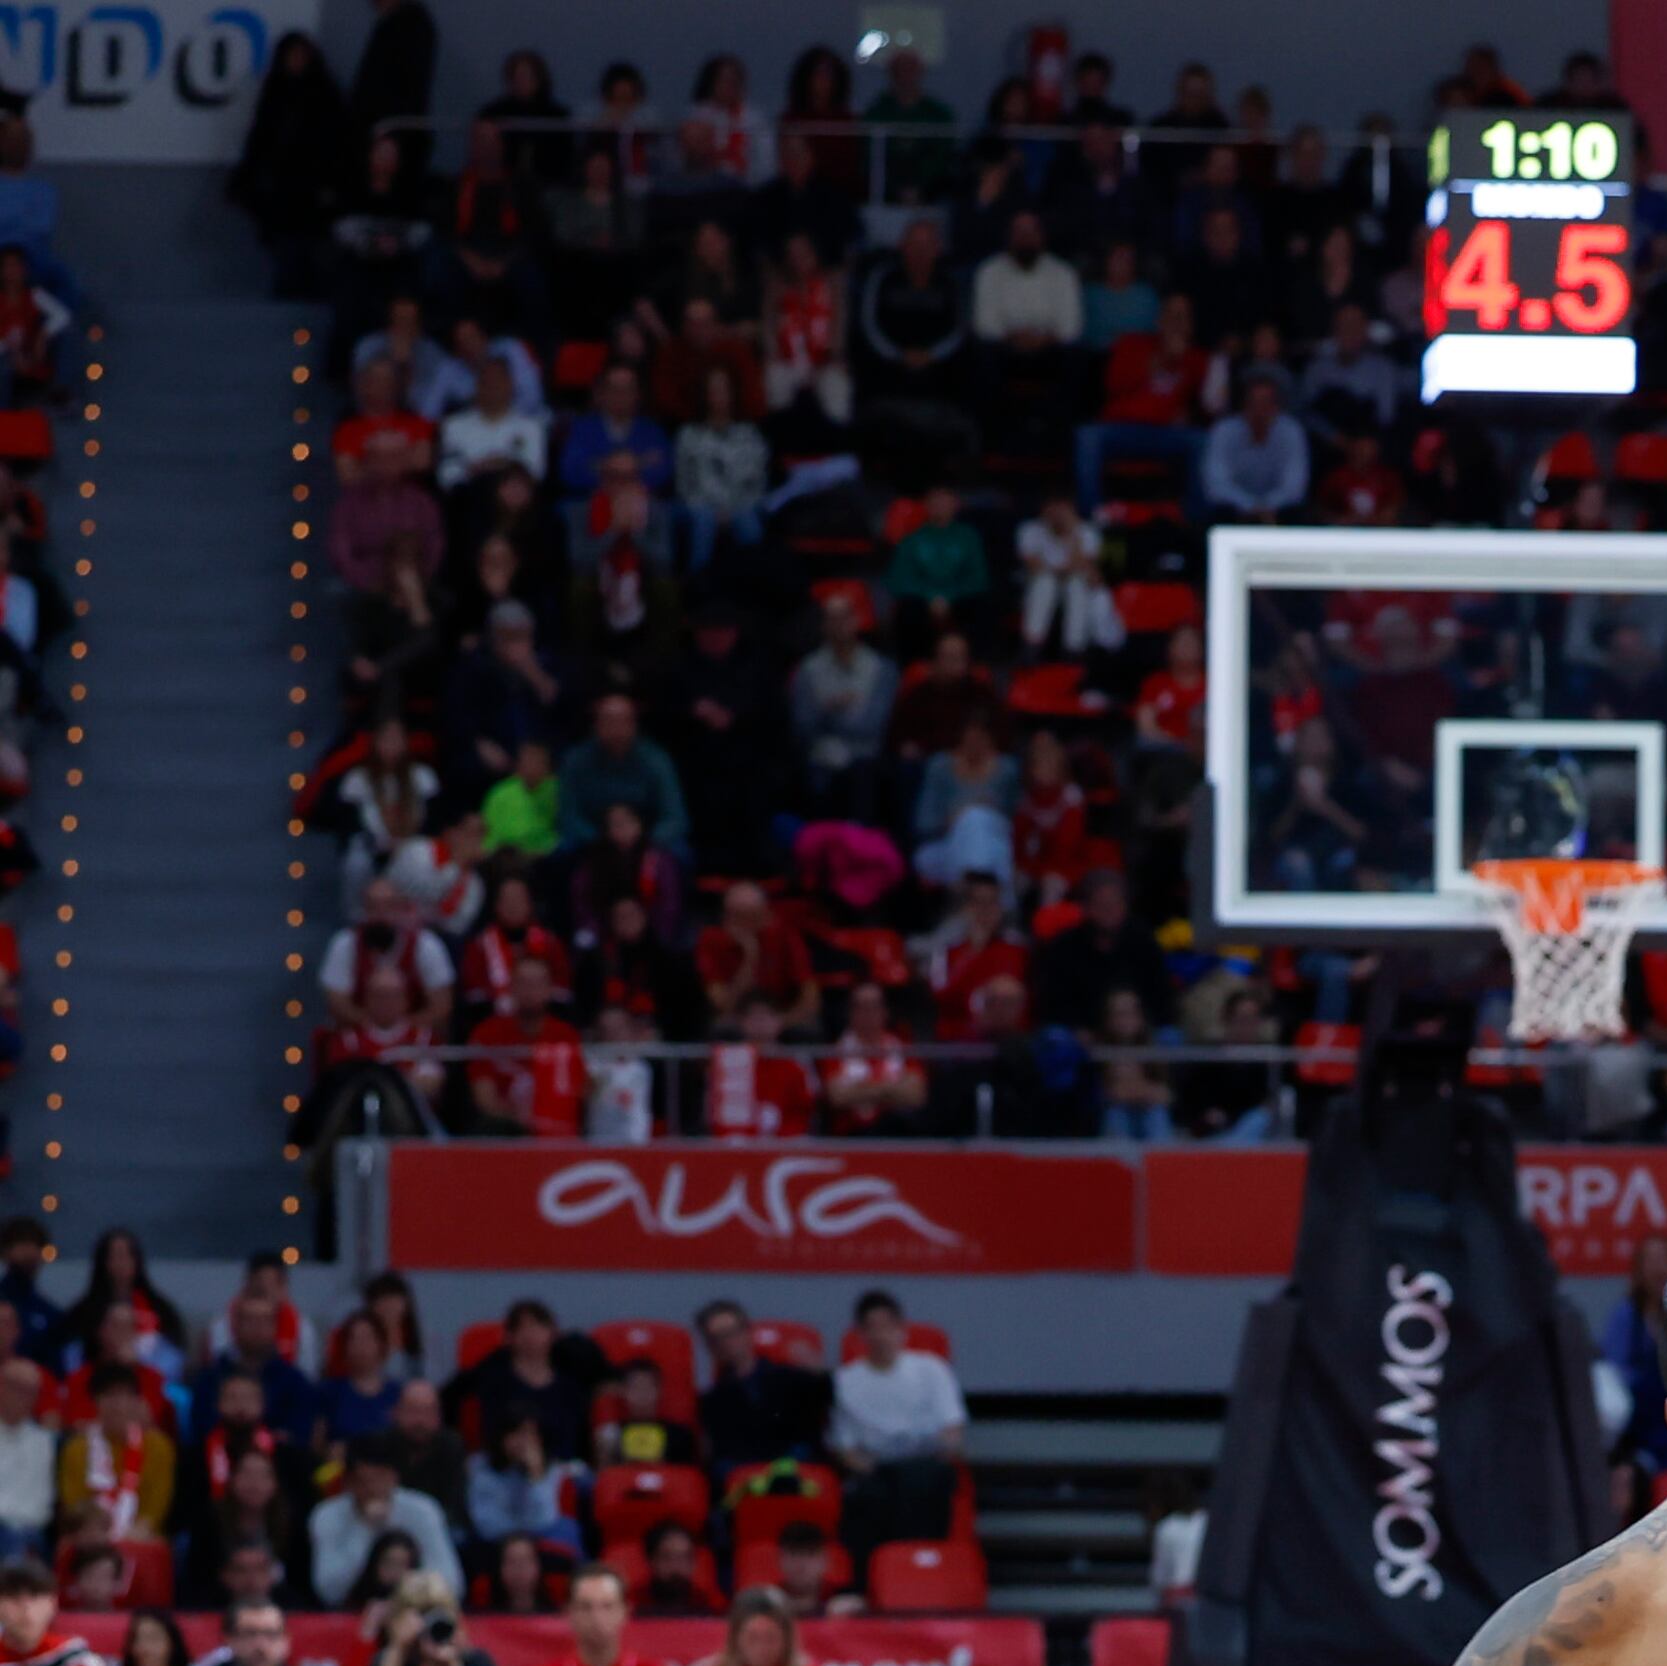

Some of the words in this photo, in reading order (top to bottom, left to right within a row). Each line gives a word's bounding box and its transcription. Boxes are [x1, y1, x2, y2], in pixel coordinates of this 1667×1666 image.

[1482, 119, 1618, 181] 1:10
[1441, 219, 1632, 335] 4.5
[536, 1156, 968, 1249] aura
[1372, 1263, 1453, 1601] SOMMOS
